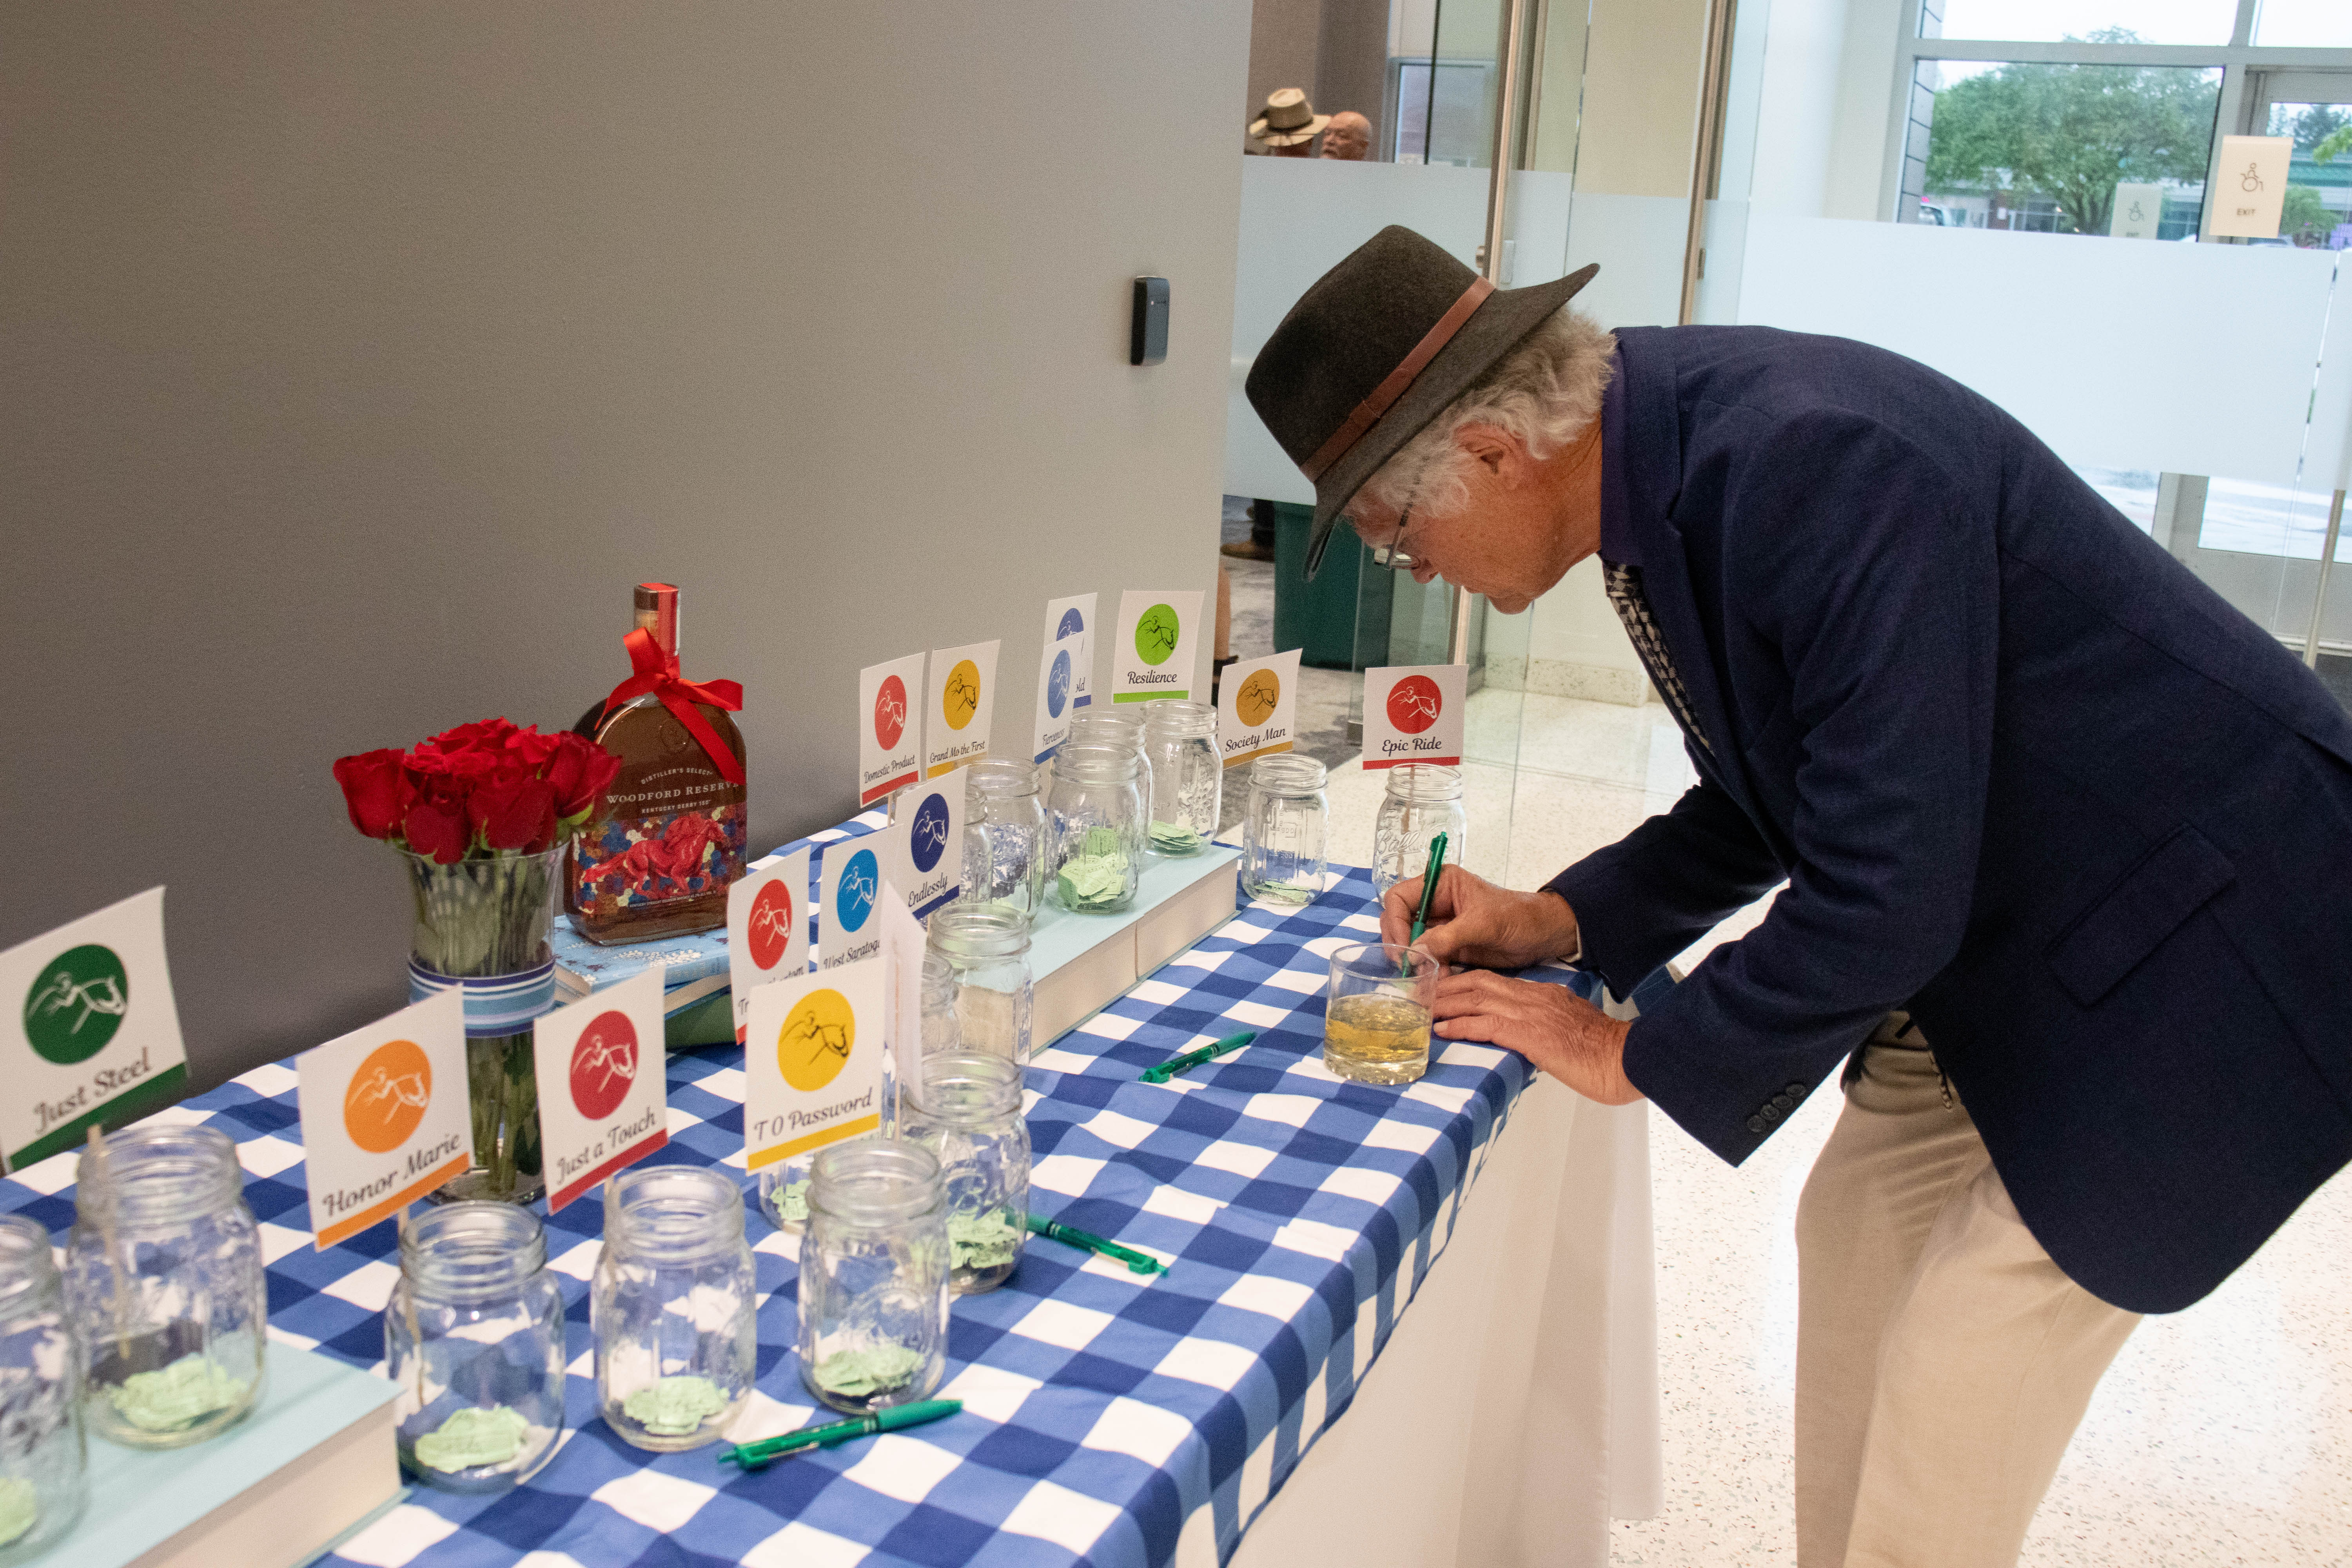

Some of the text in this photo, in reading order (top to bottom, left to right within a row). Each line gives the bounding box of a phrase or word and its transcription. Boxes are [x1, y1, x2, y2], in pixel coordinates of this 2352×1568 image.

[1127, 670, 1177, 684] Resilience
[930, 740, 985, 763] Grand Mo the First
[1225, 727, 1286, 753] Society Man
[1382, 737, 1442, 756] Epic Ride
[641, 768, 684, 784] DISTILLER'S
[864, 755, 915, 783] Domestic Product
[606, 789, 681, 804] WOODFORD
[642, 805, 675, 814] KENTUCKY
[1377, 828, 1420, 855] Ball
[907, 872, 949, 908] Endlessly
[824, 953, 845, 969] West
[33, 1047, 151, 1133] Just Steel
[754, 1120, 769, 1141] T
[788, 1087, 872, 1130] Password
[557, 1105, 656, 1184] Just a Touch
[323, 1132, 461, 1217] Honor Marie
